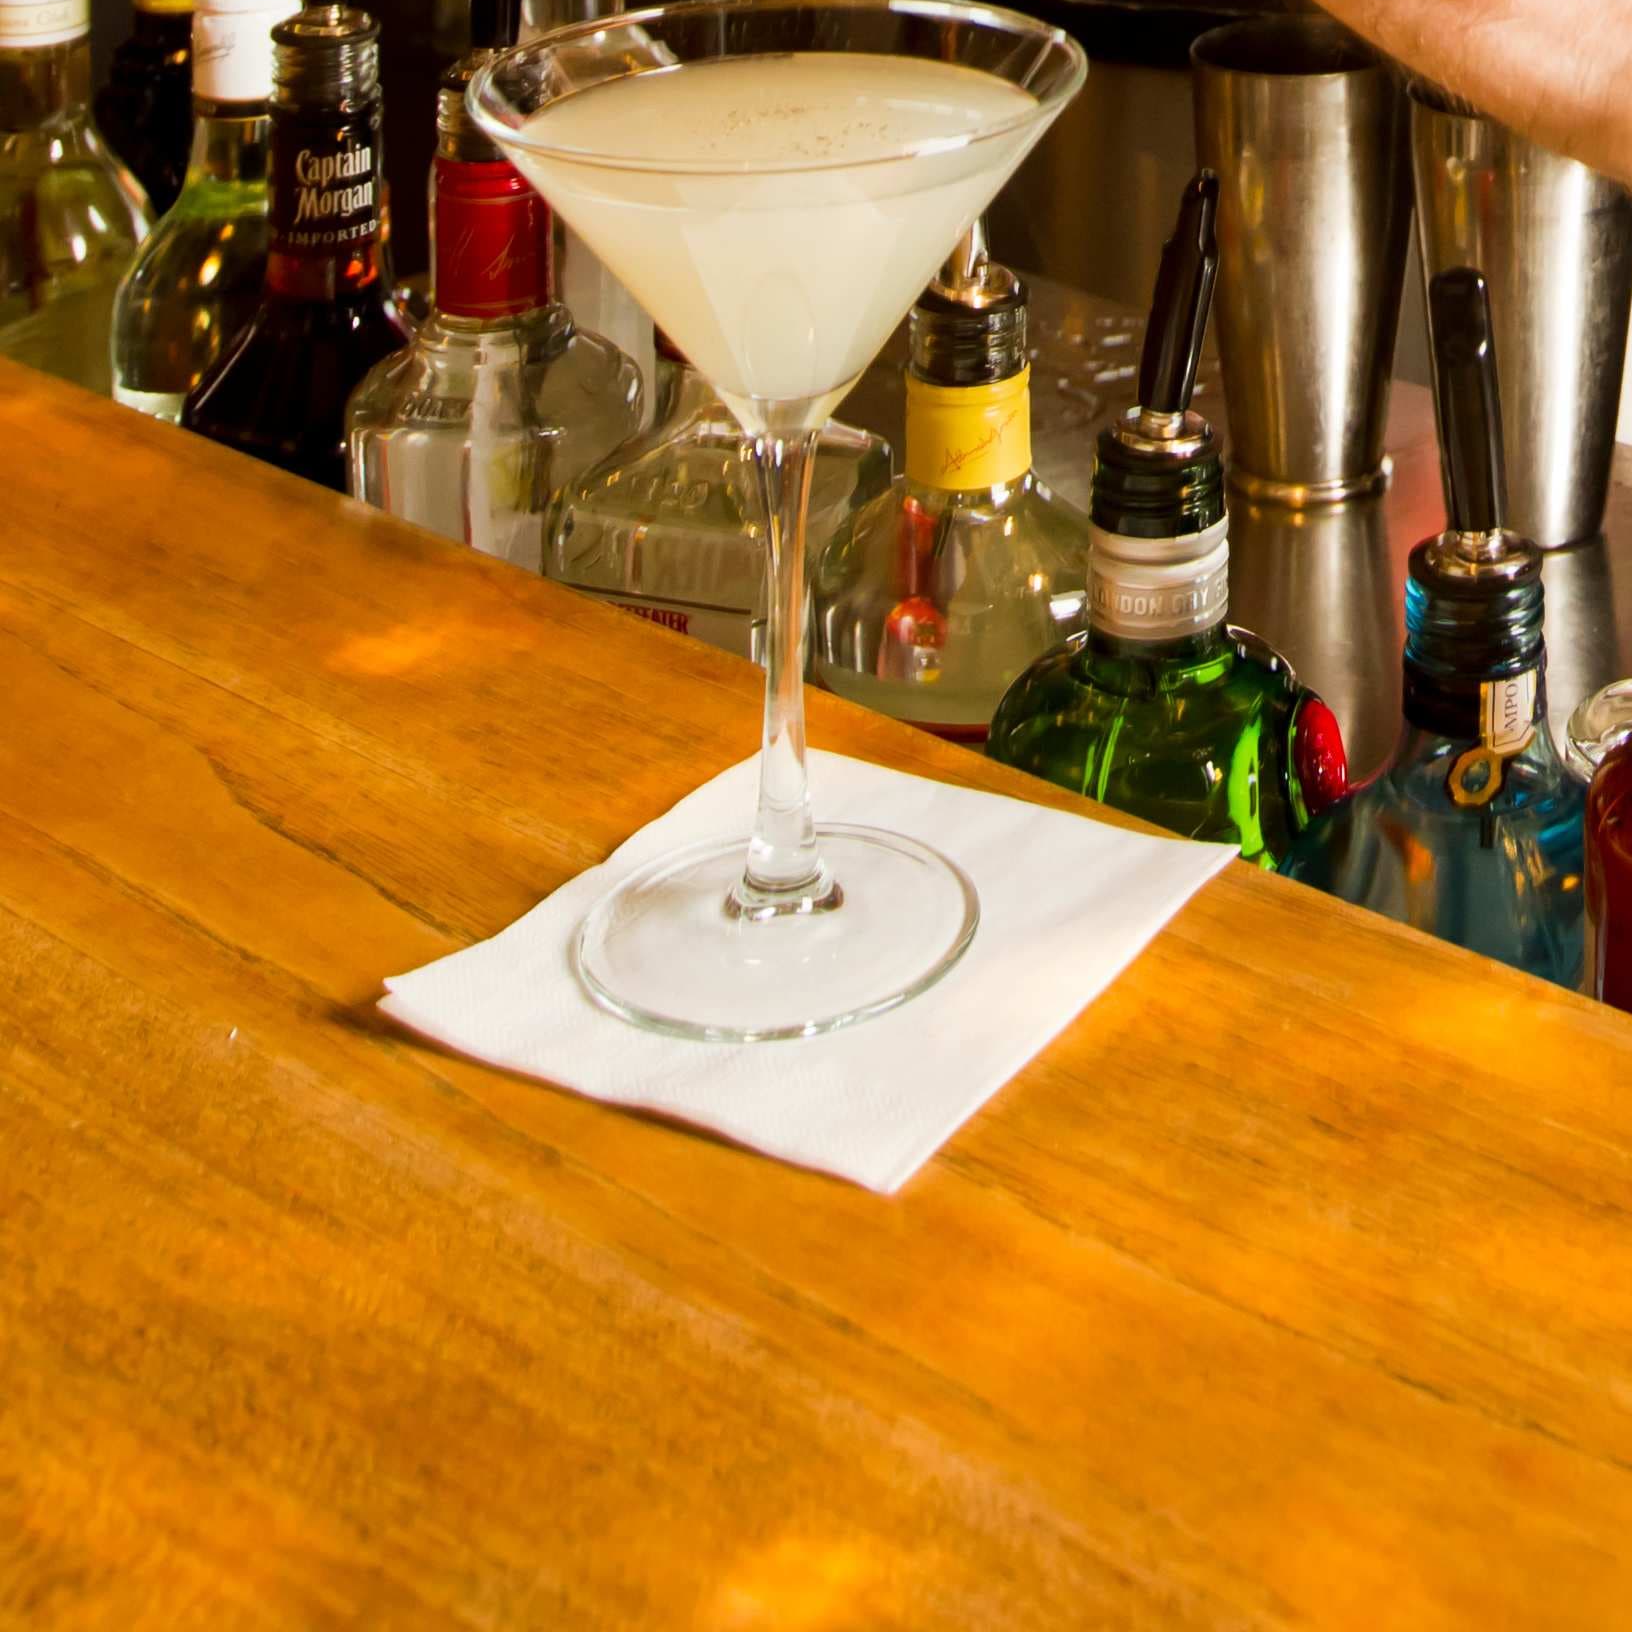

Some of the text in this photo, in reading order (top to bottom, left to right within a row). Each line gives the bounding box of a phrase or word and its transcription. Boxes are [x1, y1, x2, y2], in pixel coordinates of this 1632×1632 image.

[295, 142, 371, 190] Captain
[293, 179, 374, 225] Morgan
[287, 218, 378, 247] IMPORTED
